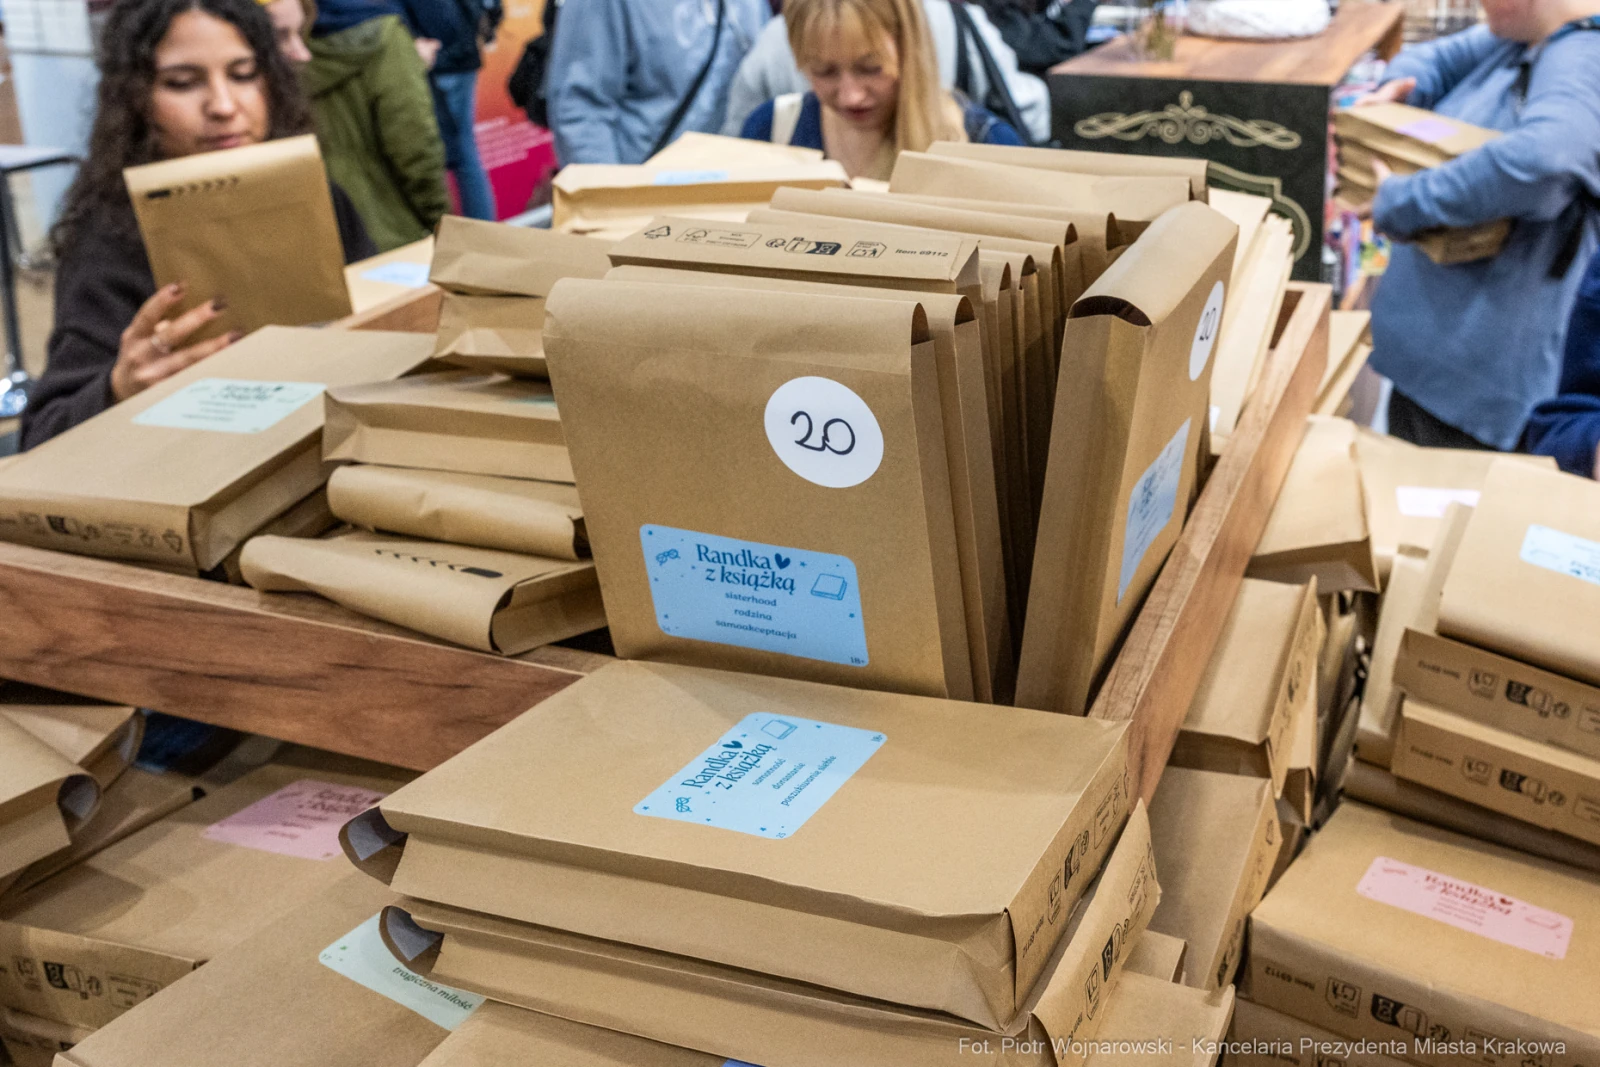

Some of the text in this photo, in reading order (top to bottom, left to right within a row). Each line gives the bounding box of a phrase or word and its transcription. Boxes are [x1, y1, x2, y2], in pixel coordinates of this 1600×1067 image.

[1198, 306, 1217, 342] 20
[790, 410, 856, 455] 20
[696, 543, 772, 570] Randka
[705, 565, 796, 596] z książką
[724, 591, 777, 607] sisterhood
[734, 608, 773, 621] rodzina
[715, 619, 798, 640] samoakceptacja
[681, 750, 740, 789] Randka
[715, 743, 777, 790] z książką
[752, 757, 787, 786] samotność
[771, 762, 806, 790] dorastanie
[781, 769, 821, 807] poszukiwanie
[392, 966, 440, 993] tragiczna
